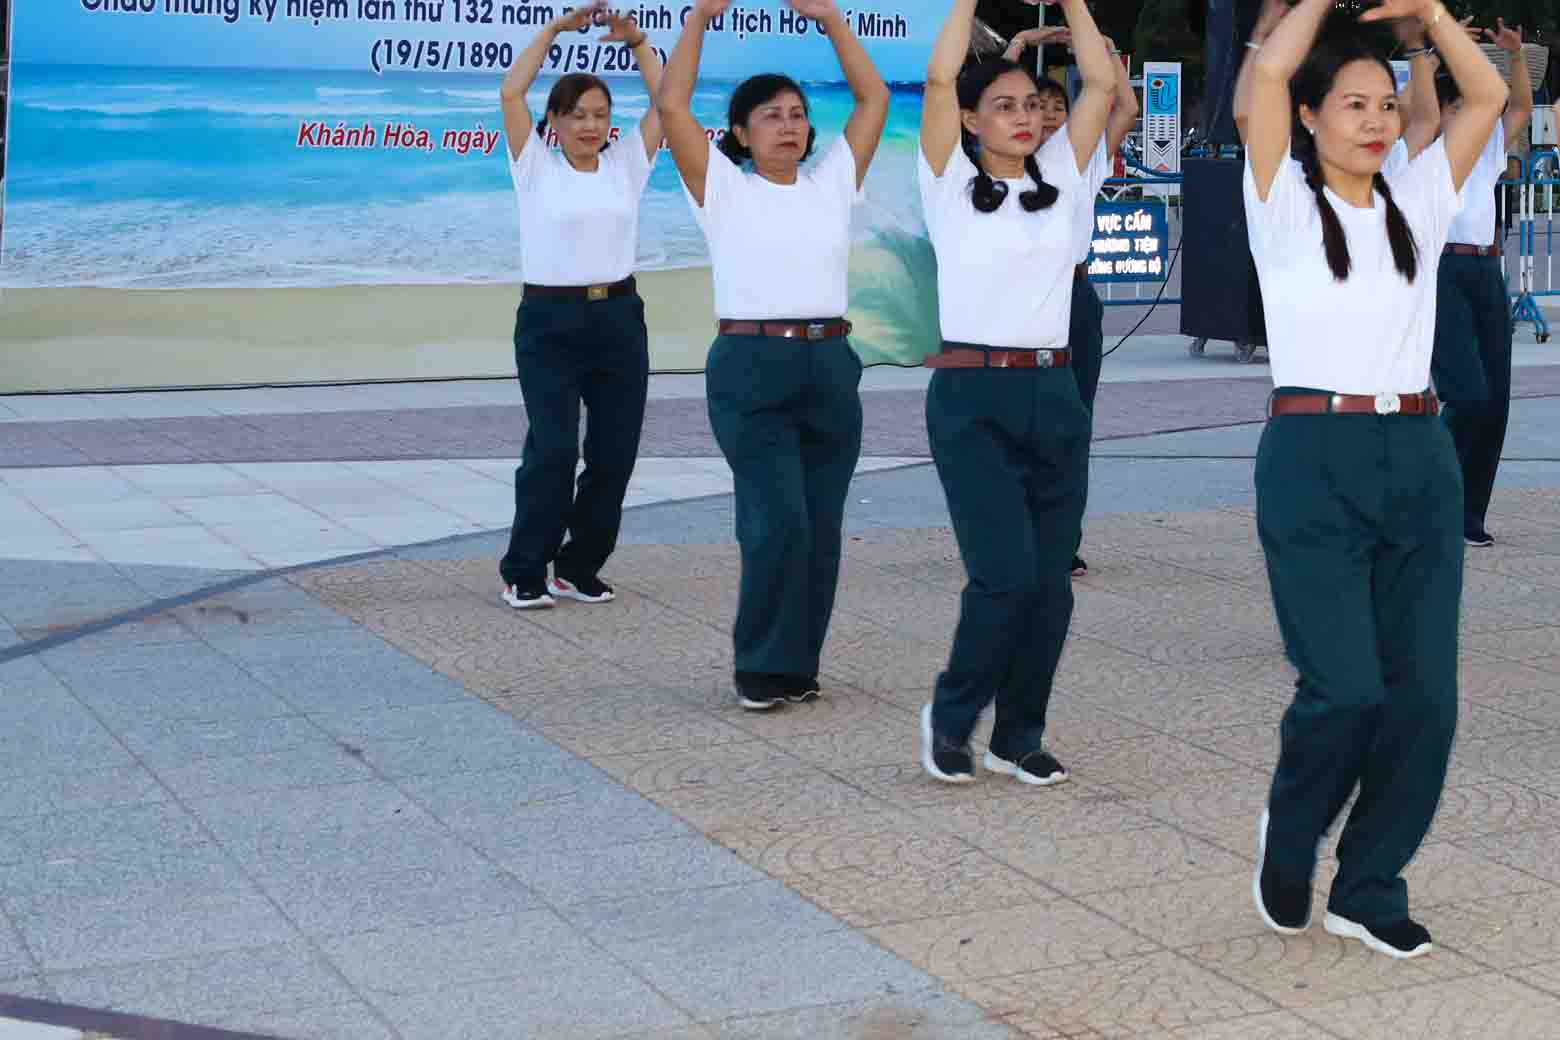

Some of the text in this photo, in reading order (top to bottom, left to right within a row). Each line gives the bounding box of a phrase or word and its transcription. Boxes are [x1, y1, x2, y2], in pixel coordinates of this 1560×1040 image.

[501, 0, 554, 26] năm
[732, 7, 772, 39] tịch
[858, 12, 908, 38] Minh
[371, 39, 513, 72] (19/5/1890
[297, 121, 376, 147] Khánh
[383, 122, 434, 151] Hòa,
[443, 125, 500, 155] ngày
[1096, 208, 1153, 235] VỰC CẤM
